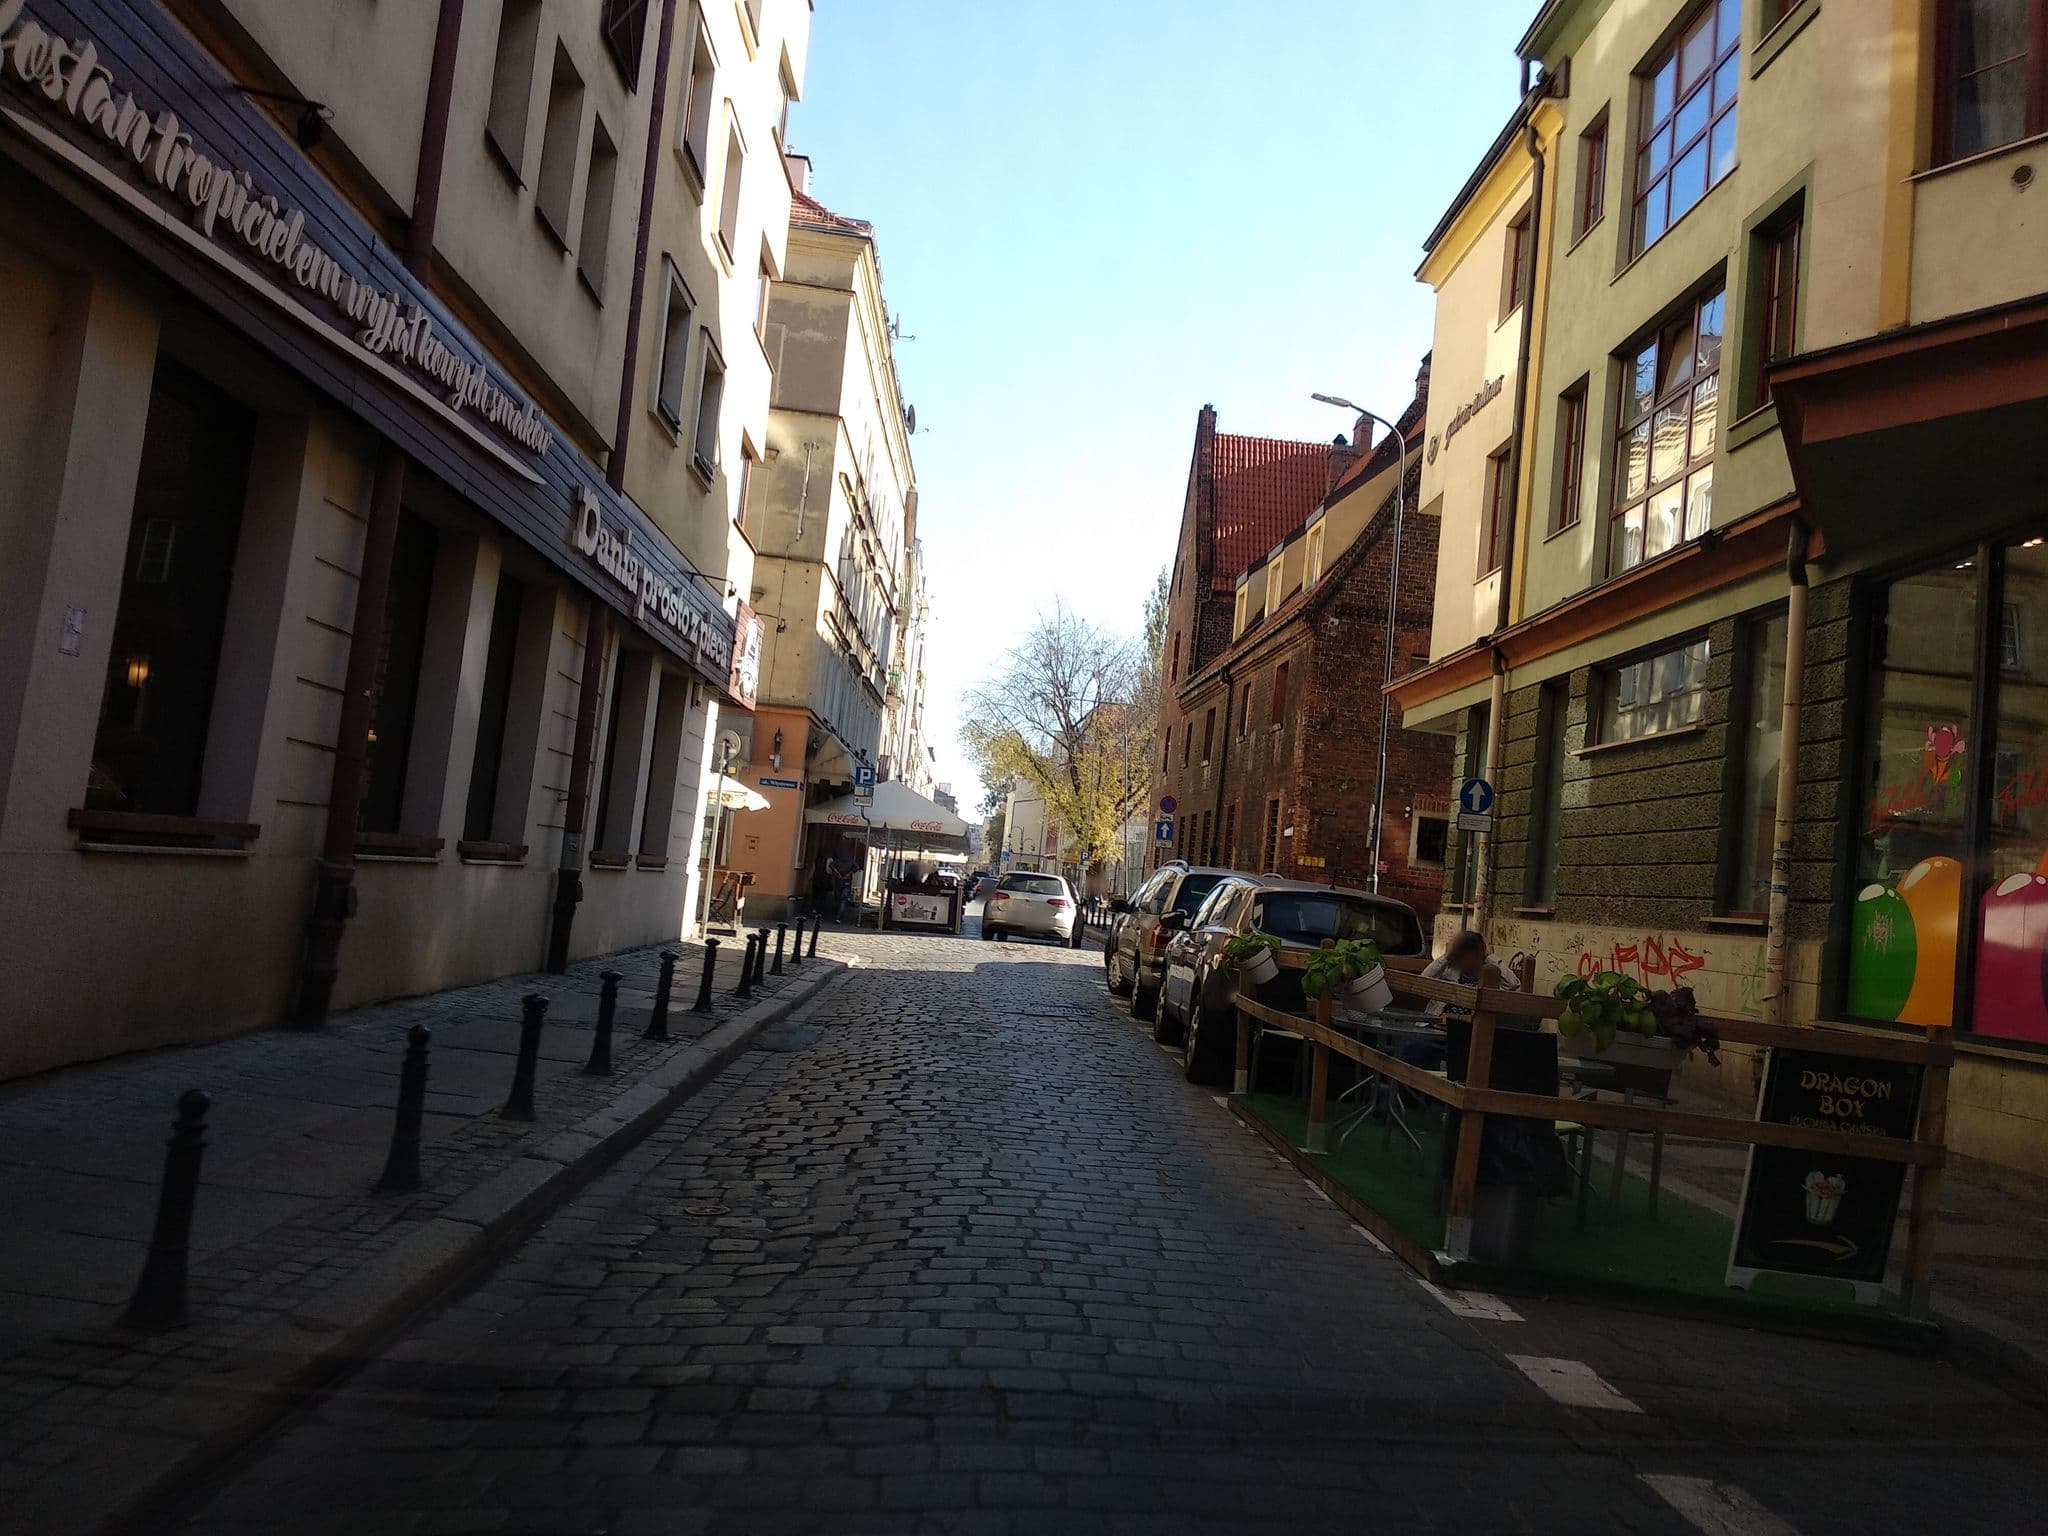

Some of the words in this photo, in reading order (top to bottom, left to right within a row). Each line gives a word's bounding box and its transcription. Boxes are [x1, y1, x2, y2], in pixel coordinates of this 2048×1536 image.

[150, 112, 342, 301] tropicielem
[575, 484, 639, 594] Dania
[636, 567, 692, 637] prosto
[689, 614, 700, 645] z
[695, 611, 728, 670] pieca
[859, 768, 872, 784] P
[1799, 1070, 1892, 1101] DRAGON
[1817, 1094, 1865, 1118] BOX
